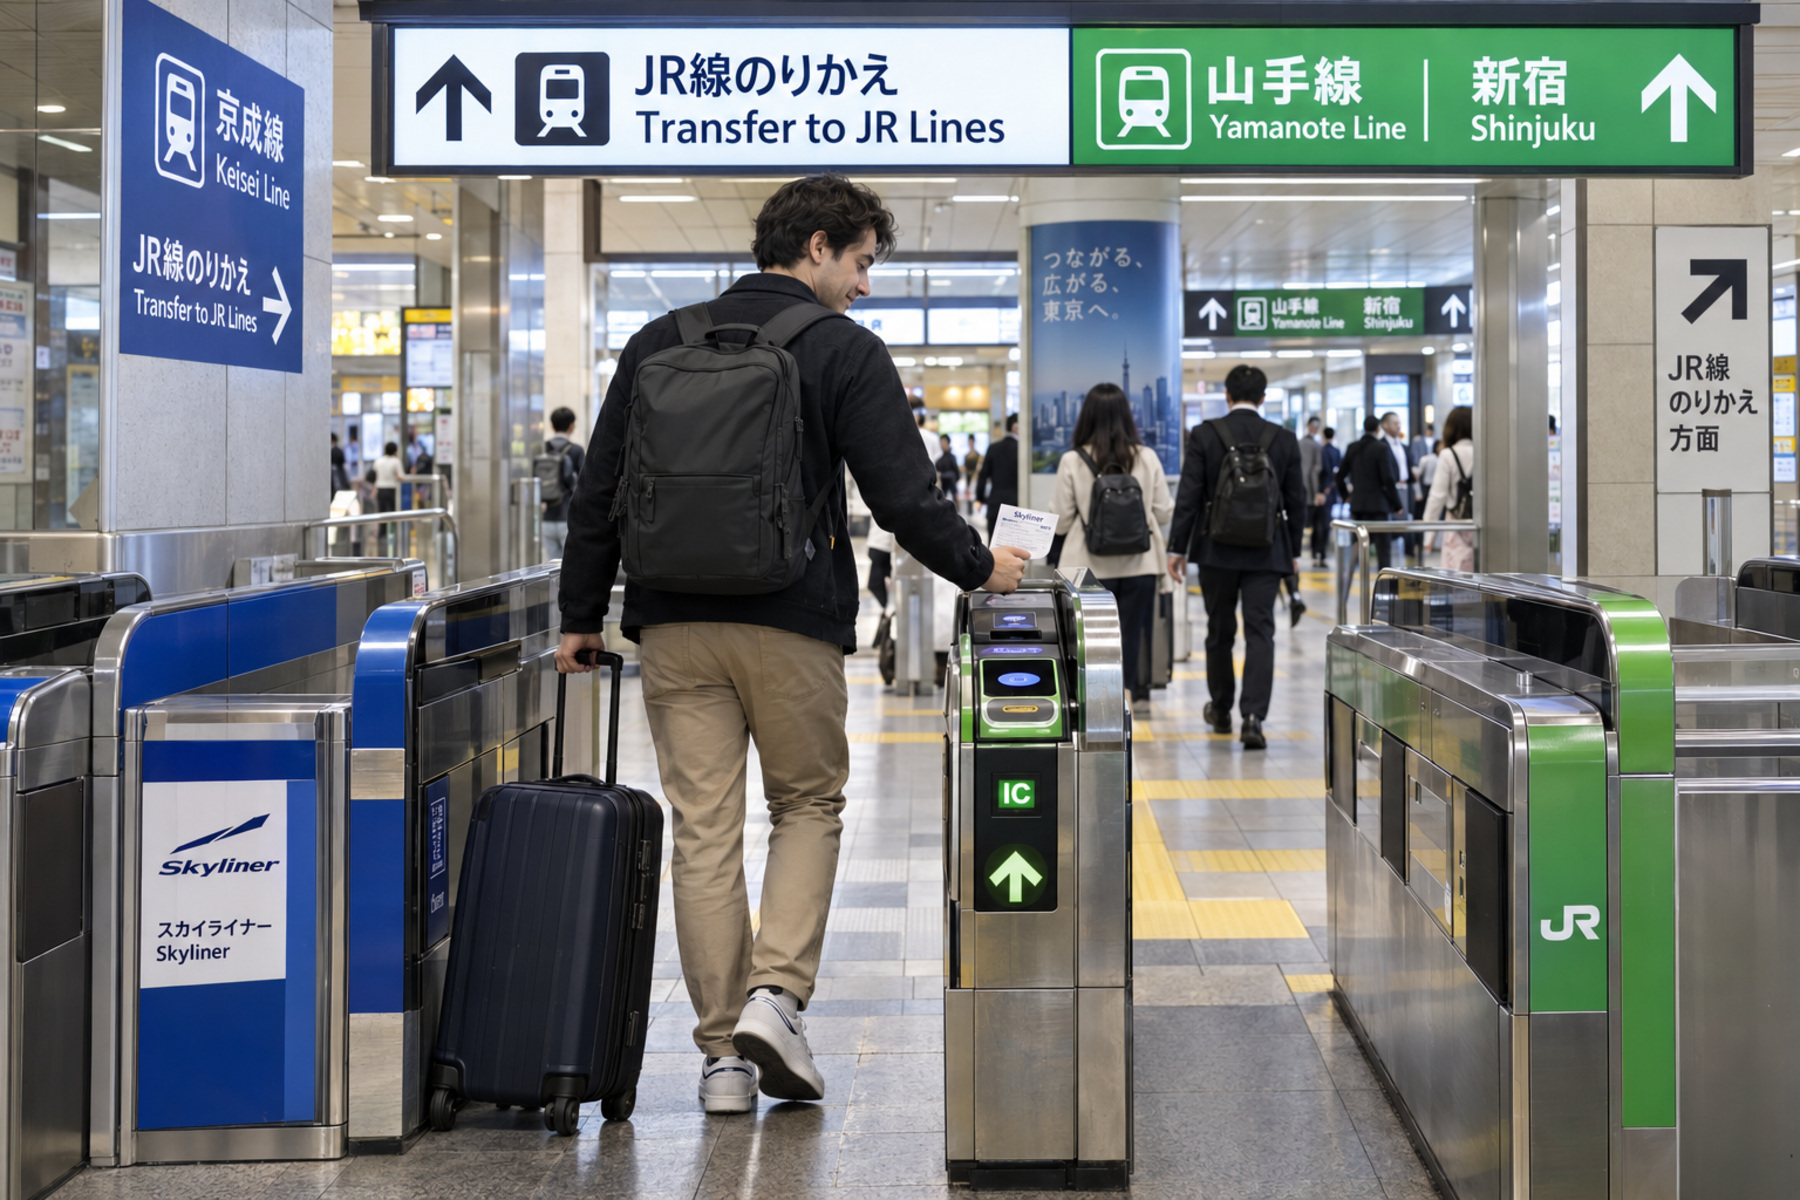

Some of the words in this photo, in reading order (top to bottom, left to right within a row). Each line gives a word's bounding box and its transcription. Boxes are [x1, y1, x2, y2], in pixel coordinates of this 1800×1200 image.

[635, 53, 898, 98] JR線のりかえ
[1208, 54, 1362, 106] 山手線
[1471, 55, 1568, 106] 新宿
[216, 88, 284, 163] 京成線
[635, 109, 797, 144] Transfer
[805, 113, 846, 144] to
[855, 110, 899, 144] JR
[910, 110, 1005, 144] Lines
[1209, 114, 1346, 141] Yamanote
[1353, 114, 1407, 141] Line
[1471, 112, 1595, 149] Shinjuku
[216, 153, 260, 199] Keisei
[263, 172, 290, 210] Line
[133, 233, 251, 296] JR線のりかえ
[1043, 246, 1143, 270] つながる、
[1042, 272, 1120, 297] 広がる、
[134, 287, 192, 322] Transfer
[195, 302, 208, 325] to
[210, 303, 226, 328] JR
[228, 307, 257, 333] Lines
[1042, 298, 1120, 323] 東京へ。
[1271, 297, 1320, 316] 山手線
[1363, 296, 1401, 316] 新宿
[1272, 317, 1321, 330] Yamanote
[1323, 317, 1346, 330] Line
[1363, 316, 1414, 331] Shinjuku
[1667, 353, 1731, 382] JR線
[1669, 388, 1759, 416] のりかえ
[1669, 423, 1720, 453] 方面
[1003, 782, 1031, 805] IC
[158, 857, 281, 878] Skyliner
[157, 918, 273, 940] スカイライナー
[1540, 904, 1601, 941] JR
[156, 943, 231, 967] Skyliner
